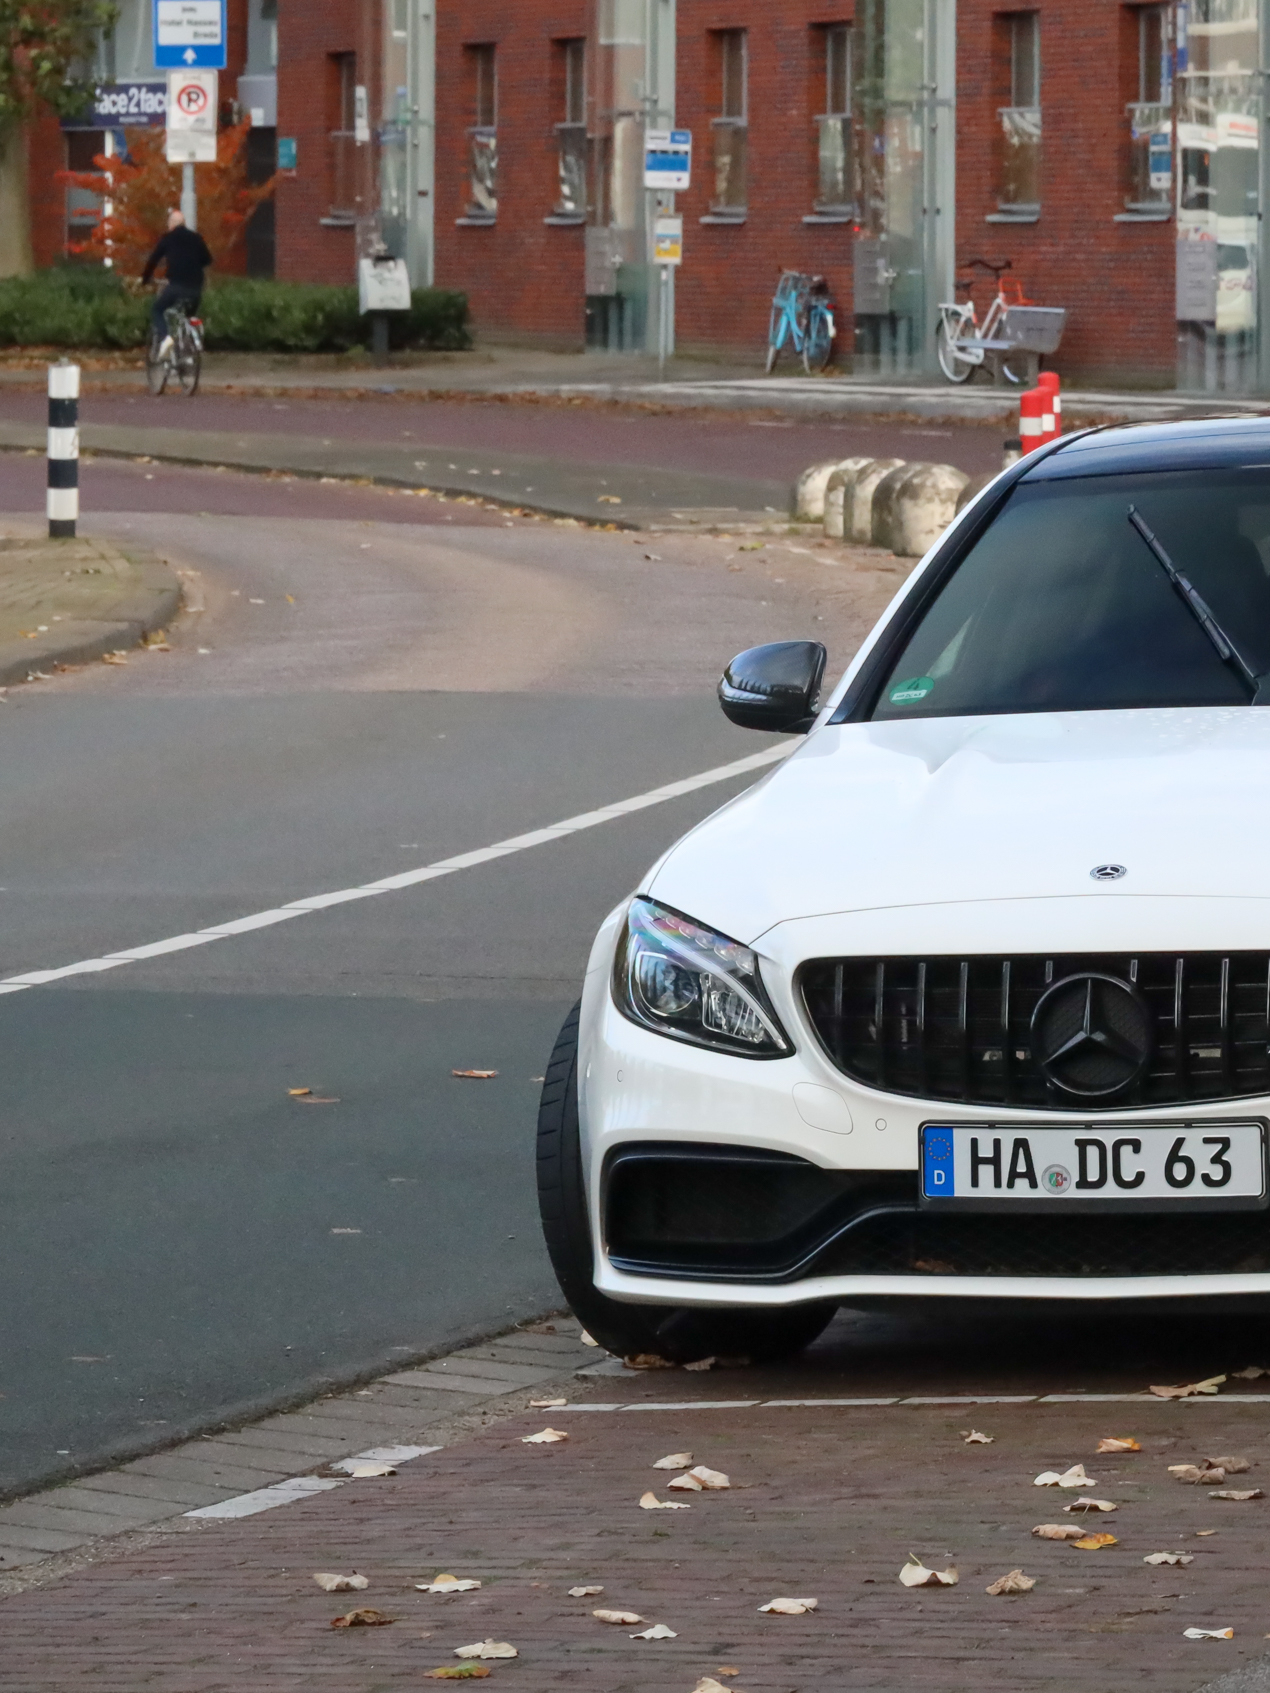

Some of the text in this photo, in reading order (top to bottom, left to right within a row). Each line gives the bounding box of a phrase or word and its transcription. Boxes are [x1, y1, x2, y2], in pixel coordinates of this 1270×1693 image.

[933, 1169, 945, 1185] D
[970, 1137, 1039, 1190] HA
[1074, 1138, 1146, 1190] DC
[1164, 1136, 1232, 1189] 63
